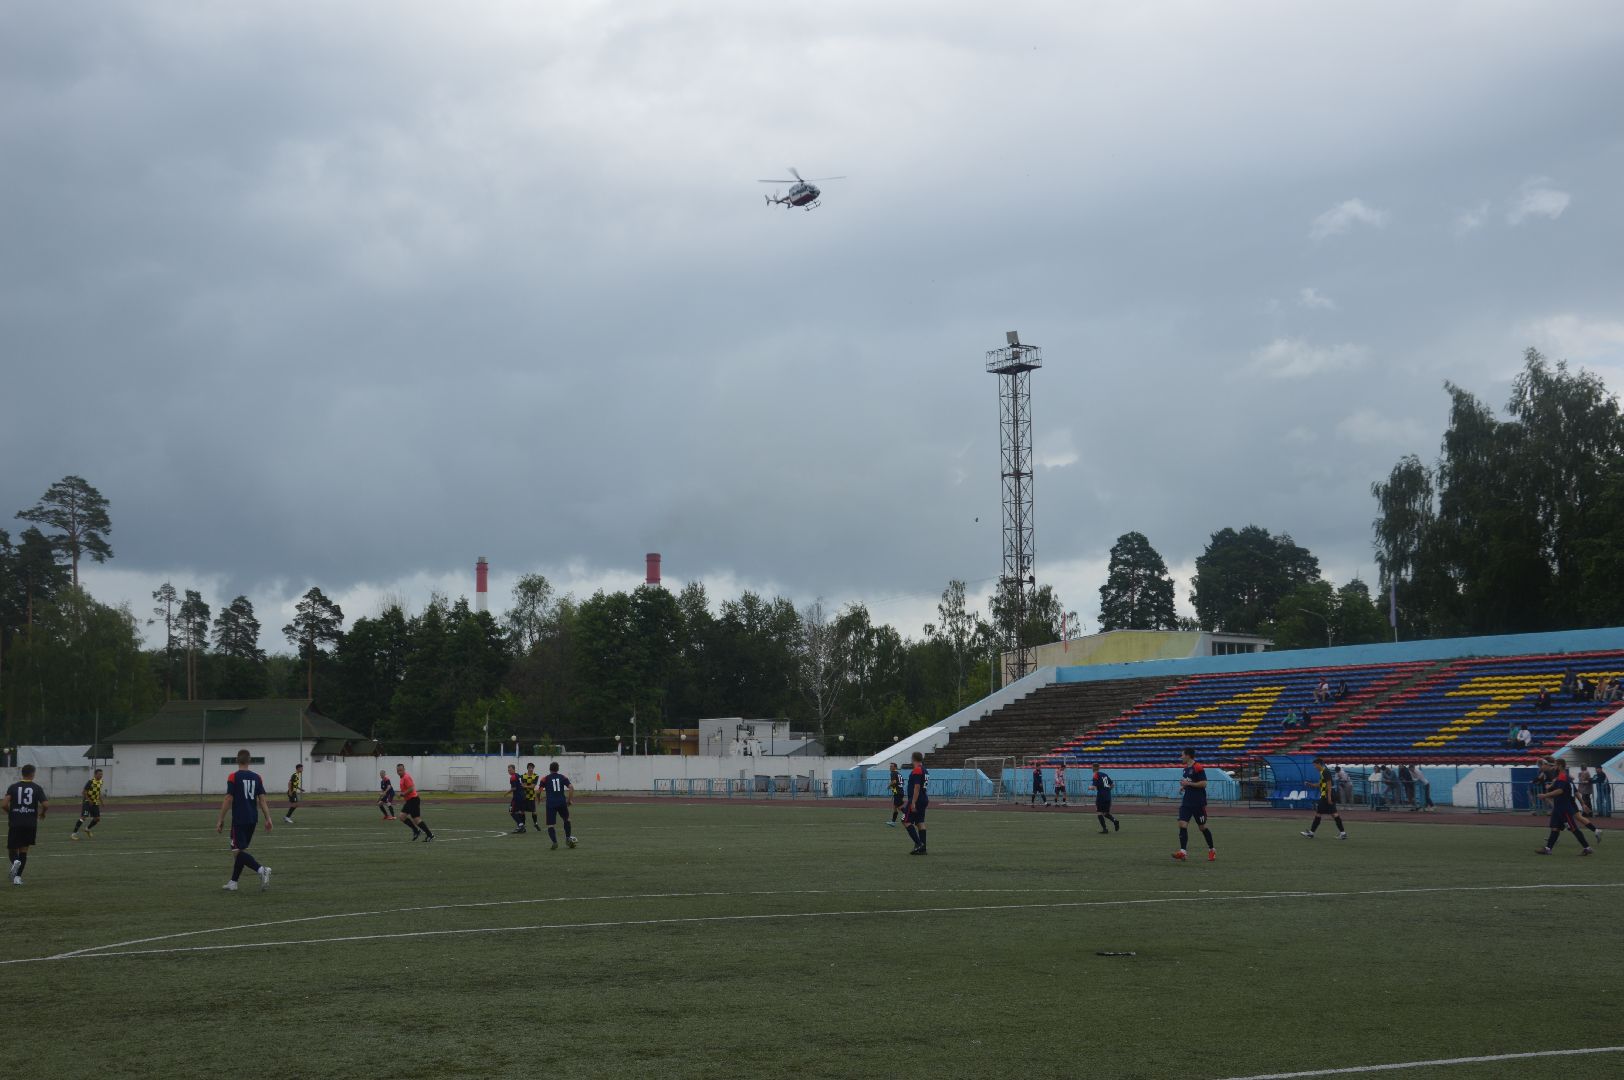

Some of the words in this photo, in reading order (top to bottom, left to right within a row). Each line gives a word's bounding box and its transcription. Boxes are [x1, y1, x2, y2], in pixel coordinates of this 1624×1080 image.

[242, 779, 256, 800] 14
[551, 778, 561, 792] 11
[17, 786, 34, 805] 13
